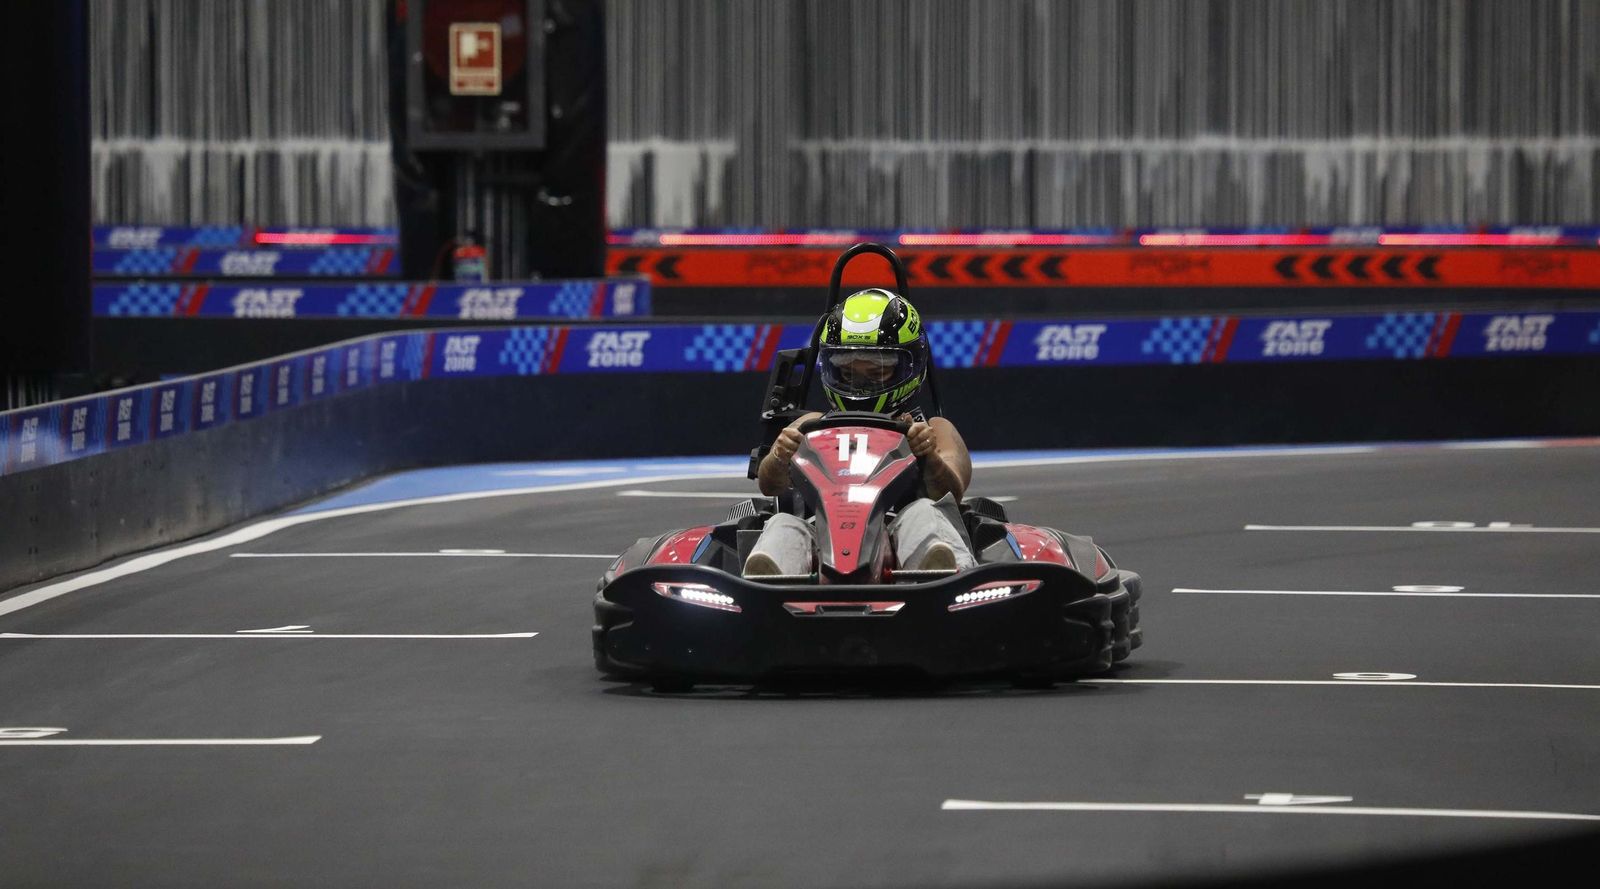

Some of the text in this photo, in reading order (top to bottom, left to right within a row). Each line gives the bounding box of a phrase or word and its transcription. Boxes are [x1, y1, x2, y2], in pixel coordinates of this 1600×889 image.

[1034, 324, 1107, 343] FAST
[1262, 320, 1332, 338] FAST
[1486, 316, 1554, 334] FAST
[444, 335, 480, 355] FAST
[586, 331, 651, 350] FAST
[836, 433, 869, 461] 11
